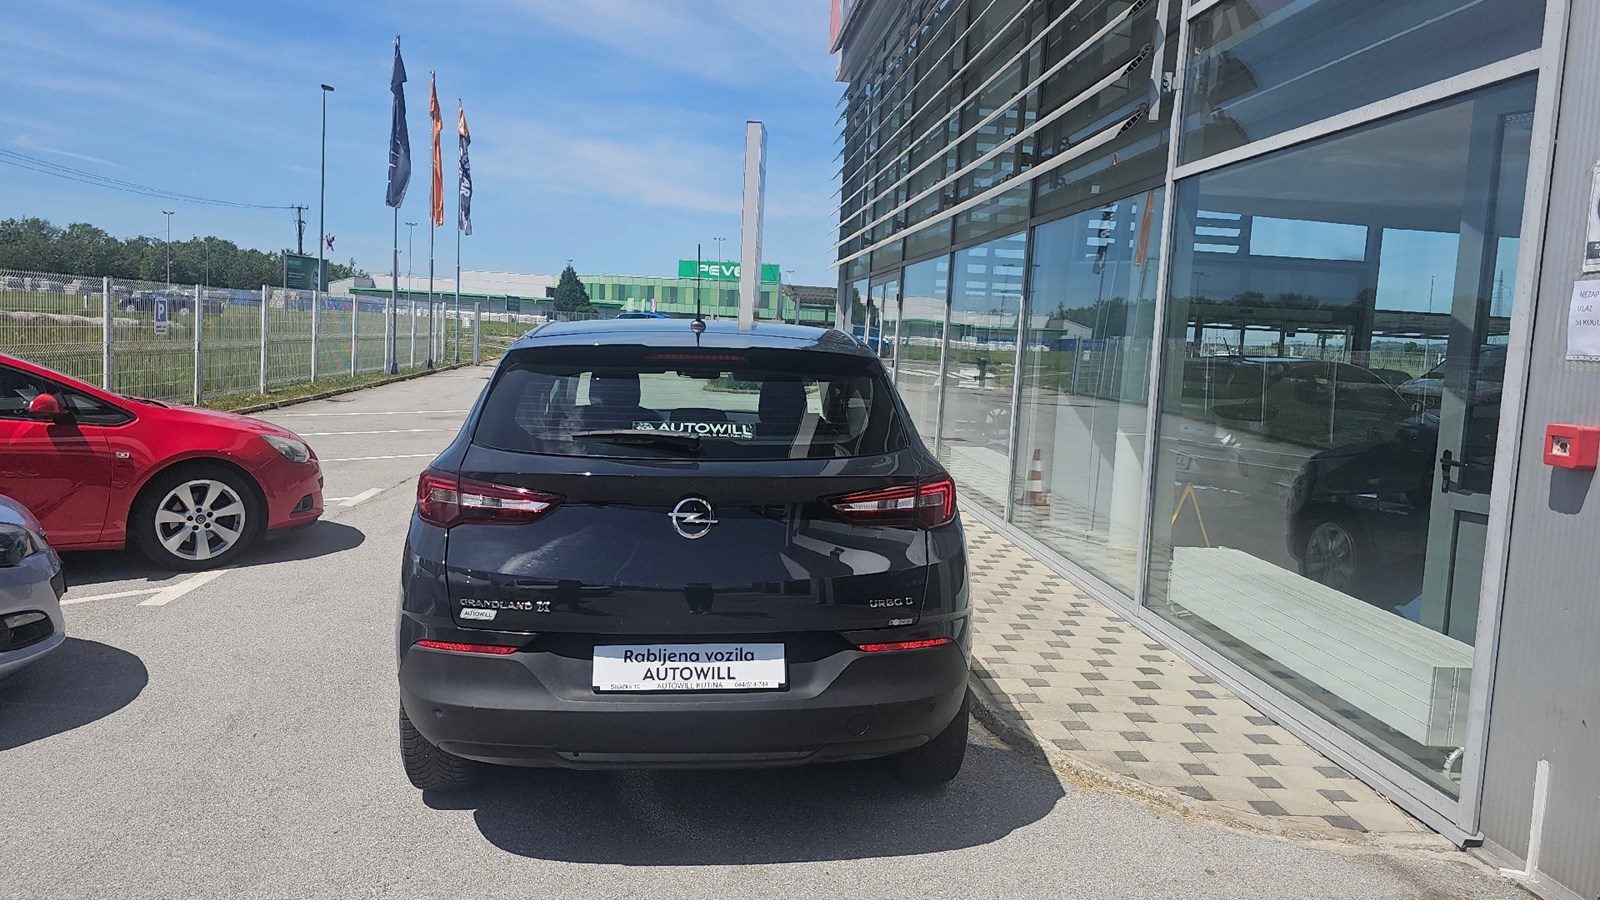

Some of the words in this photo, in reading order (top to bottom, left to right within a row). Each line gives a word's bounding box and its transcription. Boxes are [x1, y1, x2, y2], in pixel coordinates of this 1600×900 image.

[699, 264, 741, 277] PEVE
[659, 422, 752, 435] AUTOWILL
[460, 599, 533, 610] GRANDLAND
[536, 600, 551, 613] X
[464, 610, 492, 618] AUTOWILL
[624, 649, 700, 667] Rabljena
[705, 647, 755, 662] vozila
[642, 666, 736, 681] AUTOWILL
